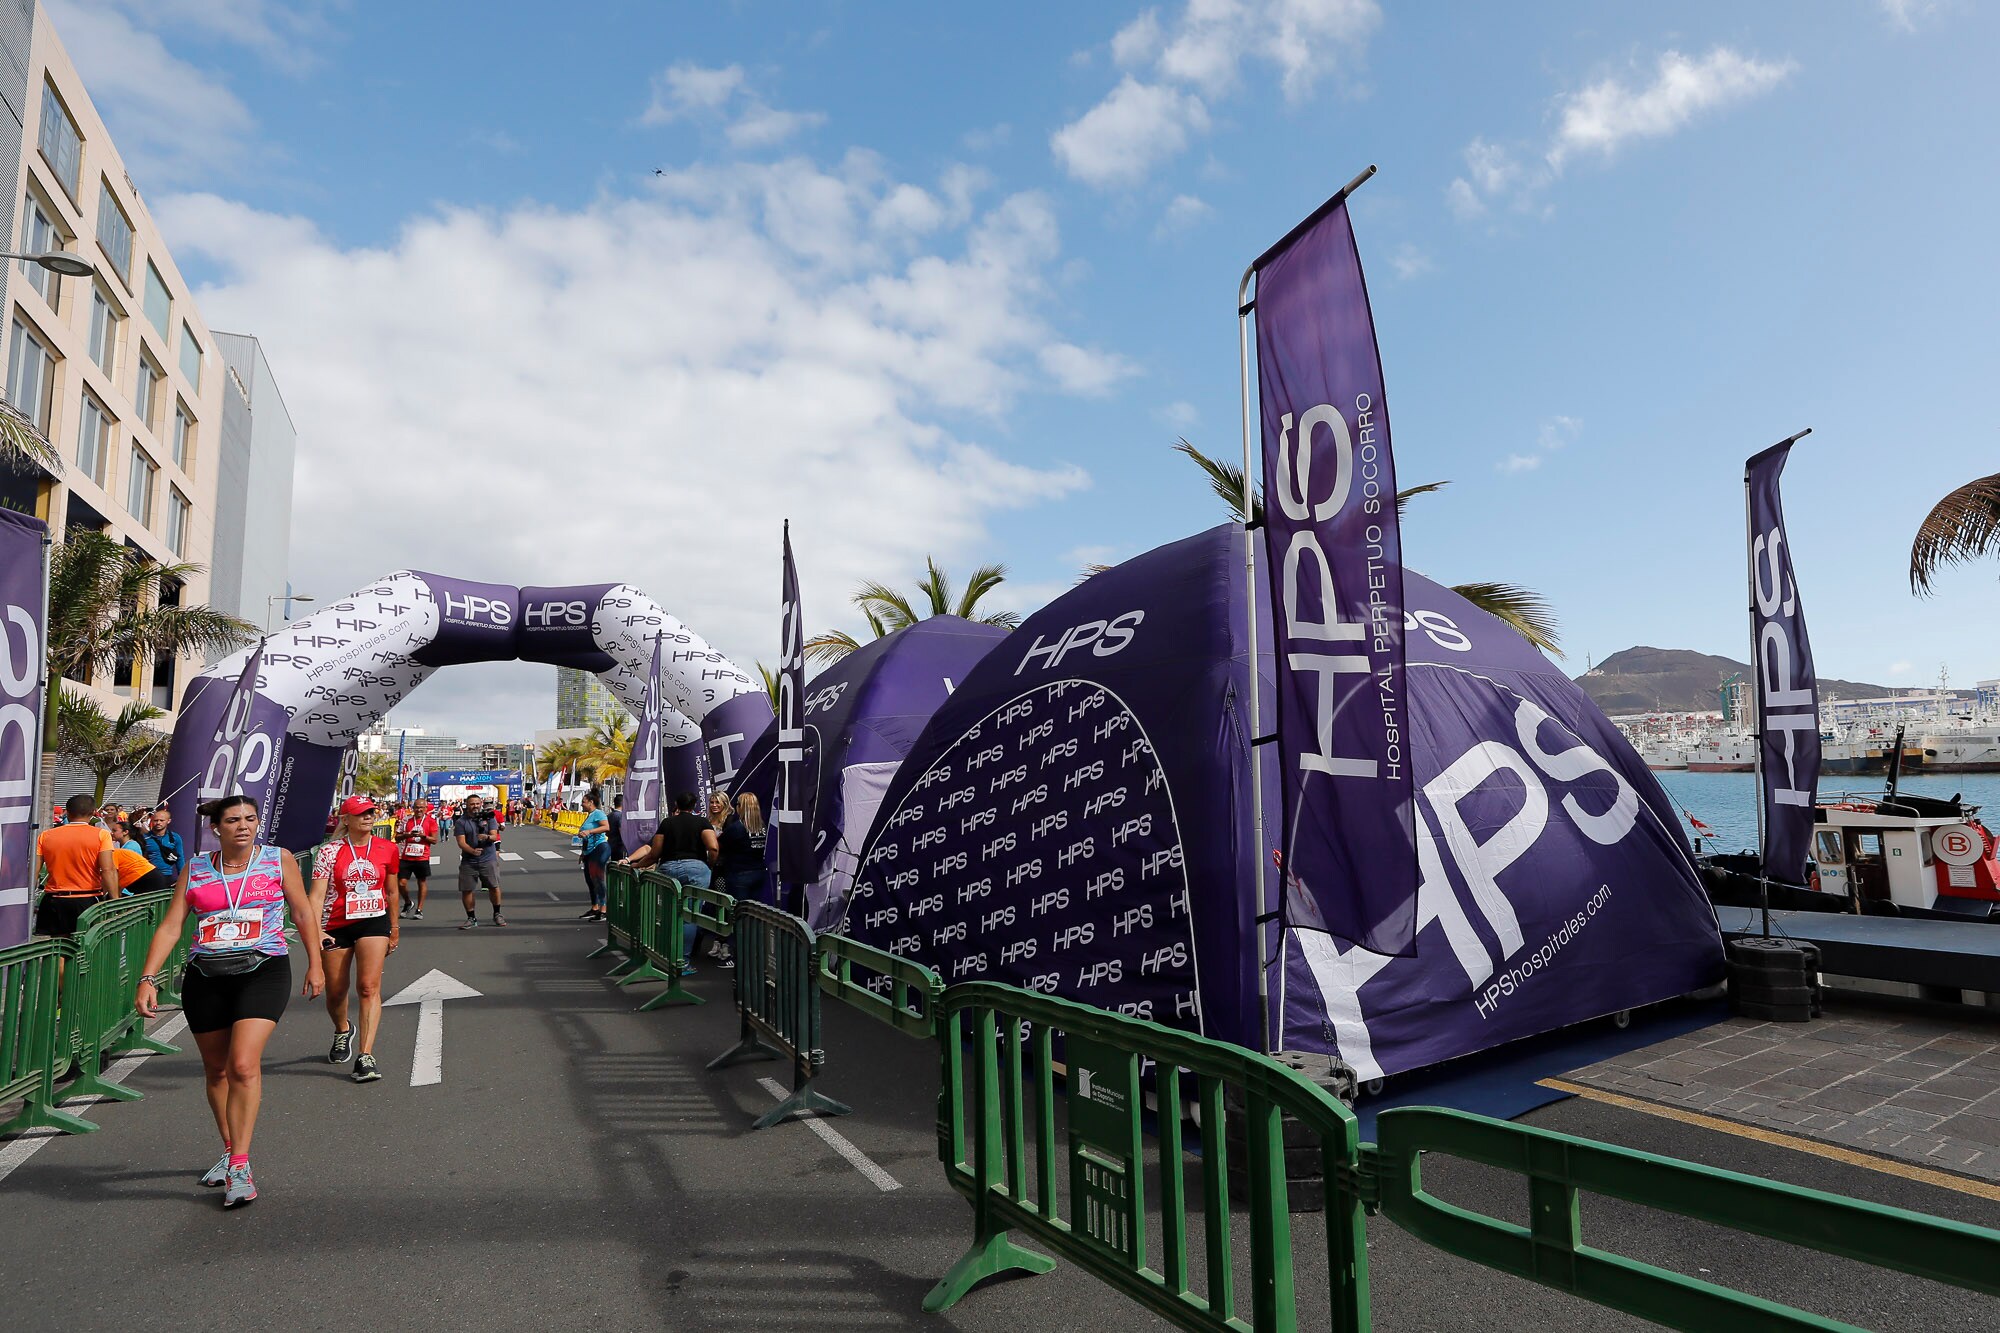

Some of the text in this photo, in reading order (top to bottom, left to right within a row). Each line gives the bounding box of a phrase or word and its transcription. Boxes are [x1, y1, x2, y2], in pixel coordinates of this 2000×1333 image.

[1276, 404, 1378, 778] HPS
[1356, 393, 1401, 780] HOSPITAL PERPETUO SOCORRO
[444, 591, 511, 625] HPS
[525, 600, 587, 626] HPS
[444, 617, 510, 631] HOSPITAL PERPETUO SOCORRO
[305, 618, 410, 682] HPShospitales.com
[672, 651, 721, 663] HPS
[1014, 610, 1145, 676] HPS
[702, 669, 749, 684] HPS
[1754, 527, 1816, 807] HPS
[779, 601, 803, 824] HPS
[997, 699, 1033, 729] HPS
[1068, 689, 1105, 723] HPS
[662, 732, 687, 743] PS
[1019, 718, 1054, 750] HPS
[1093, 710, 1130, 744] HPS
[966, 744, 1004, 772] HPS
[1040, 738, 1078, 770] HPS
[1121, 738, 1154, 768] HPS
[257, 789, 272, 839] PERPETUO
[268, 737, 282, 785] SOCORRO
[915, 765, 951, 791] HPS
[990, 764, 1027, 793] HPS
[1063, 760, 1104, 792] HPS
[271, 756, 295, 834] PERPETUO SOCORRO
[938, 786, 975, 812] HPS
[1011, 784, 1048, 815] HPS
[1083, 787, 1127, 819] HPS
[890, 805, 924, 829] HPS
[961, 807, 997, 835] HPS
[1031, 809, 1068, 841] HPS
[1111, 813, 1152, 848] HPS
[866, 843, 899, 866] HPS
[912, 826, 947, 853] HPS
[982, 832, 1016, 861] HPS
[1058, 836, 1095, 869] HPS
[1948, 836, 1967, 852] B
[933, 851, 968, 878] HPS
[1006, 858, 1042, 888] HPS
[1141, 844, 1184, 880] HPS
[245, 890, 274, 898] IMPETU
[885, 868, 919, 892] HPS
[957, 877, 991, 905] HPS
[1086, 867, 1125, 901] HPS
[1288, 698, 1641, 1085] HPS
[356, 899, 379, 911] 1316
[908, 894, 944, 919] HPS
[1031, 887, 1069, 918] HPS
[865, 907, 898, 930] HPS
[933, 921, 967, 946] HPS
[981, 905, 1016, 934] HPS
[1113, 904, 1153, 938] HPS
[890, 934, 921, 955] HPS
[1000, 938, 1037, 966] HPS
[1053, 922, 1095, 952] HPS
[1474, 882, 1613, 1021] HPShospitales.com
[953, 952, 988, 978] HPS
[1077, 959, 1122, 988] HPS
[1141, 942, 1188, 976] HPS
[867, 975, 893, 993] HPS
